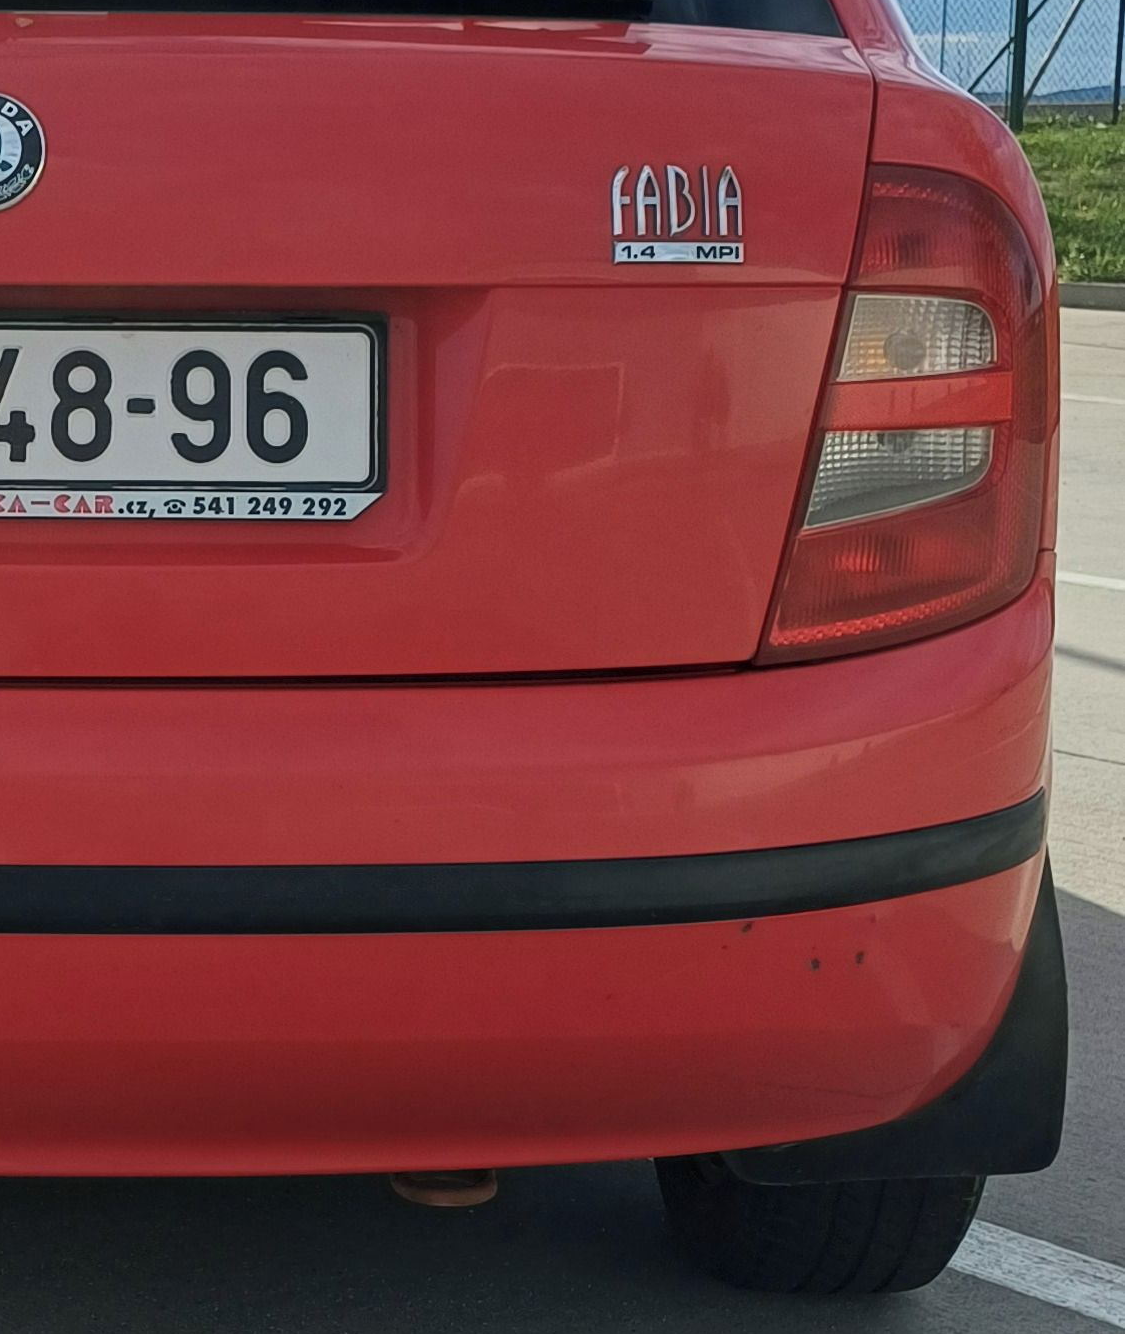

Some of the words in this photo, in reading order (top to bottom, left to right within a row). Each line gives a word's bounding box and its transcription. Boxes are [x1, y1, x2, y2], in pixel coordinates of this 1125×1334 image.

[612, 165, 743, 236] FABIA
[621, 245, 656, 259] 1.4
[696, 245, 740, 260] MPI
[192, 497, 235, 515] 541
[247, 497, 293, 515] 249
[302, 498, 347, 516] 292
